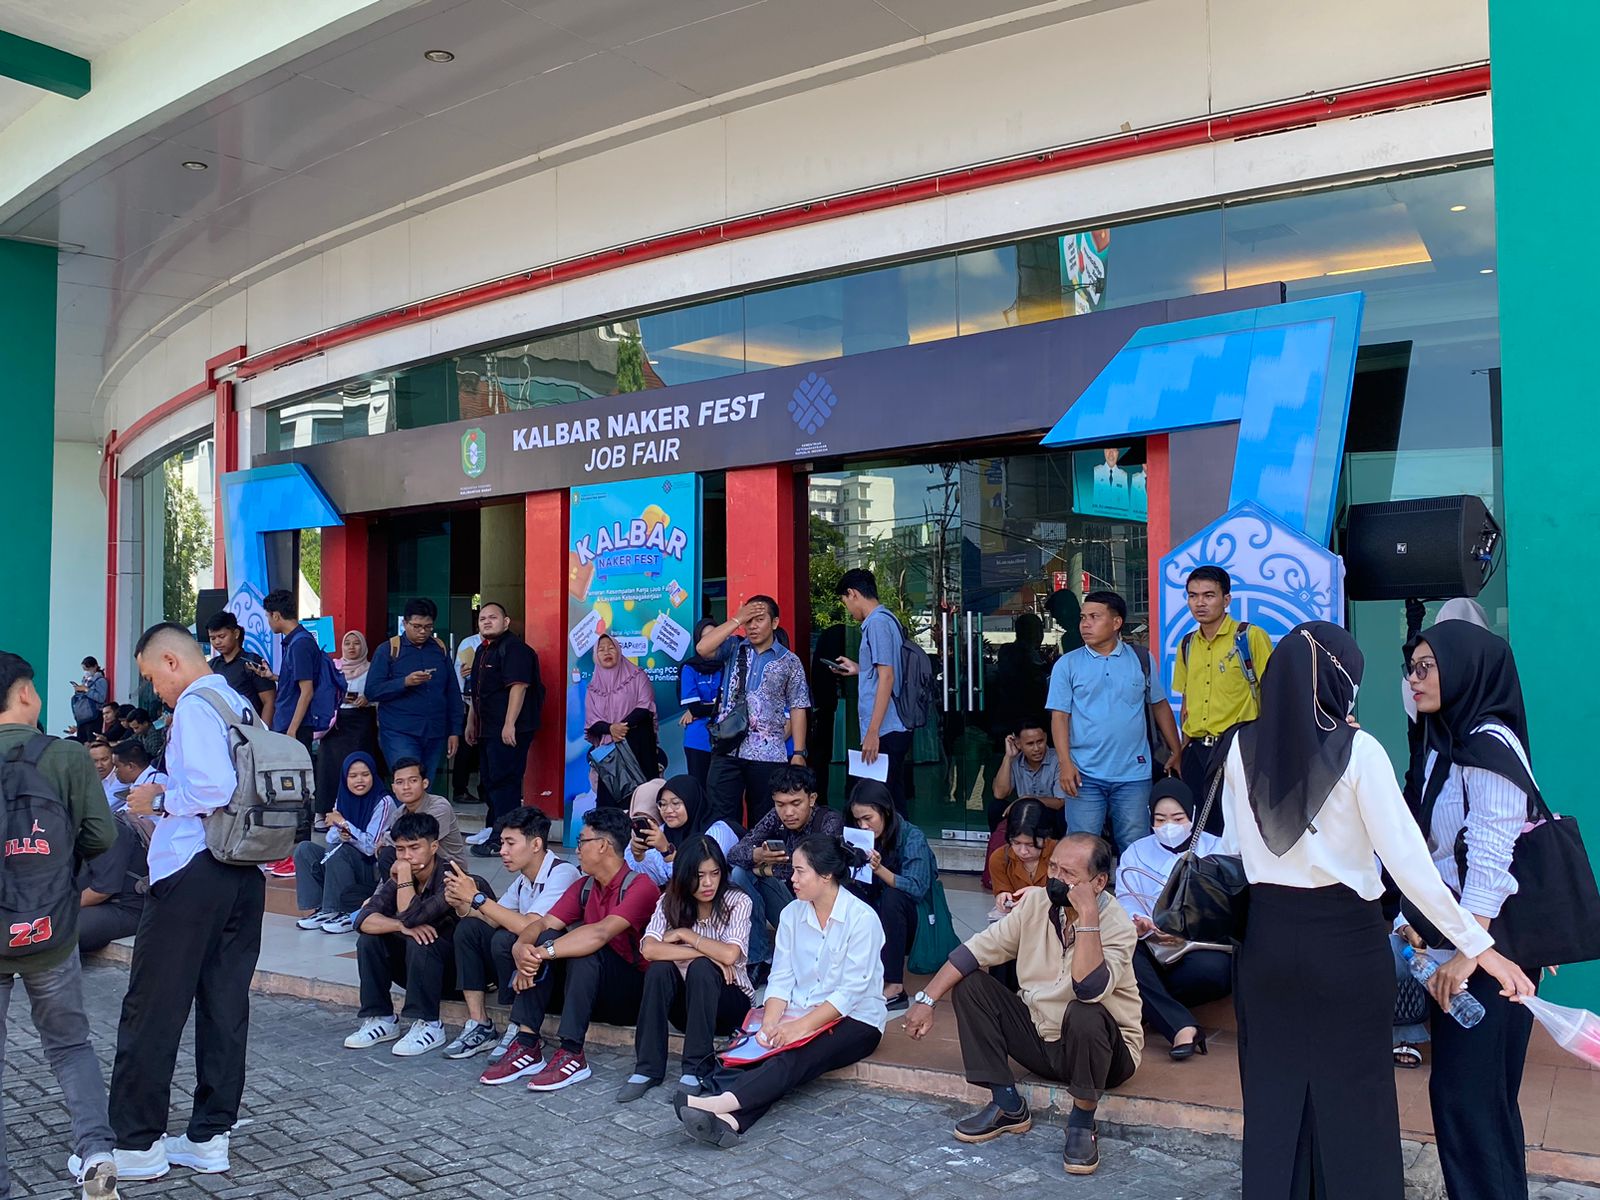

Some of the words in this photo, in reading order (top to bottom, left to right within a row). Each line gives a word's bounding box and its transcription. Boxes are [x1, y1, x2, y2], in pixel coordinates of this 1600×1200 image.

[513, 418, 600, 451] KALBAR
[608, 405, 690, 438] NAKER
[698, 393, 765, 426] FEST
[584, 444, 627, 472] JOB
[632, 438, 680, 466] FAIR
[576, 519, 687, 566] KALBAR
[599, 555, 632, 568] NAKER
[634, 554, 659, 565] FEST
[9, 916, 52, 947] 23
